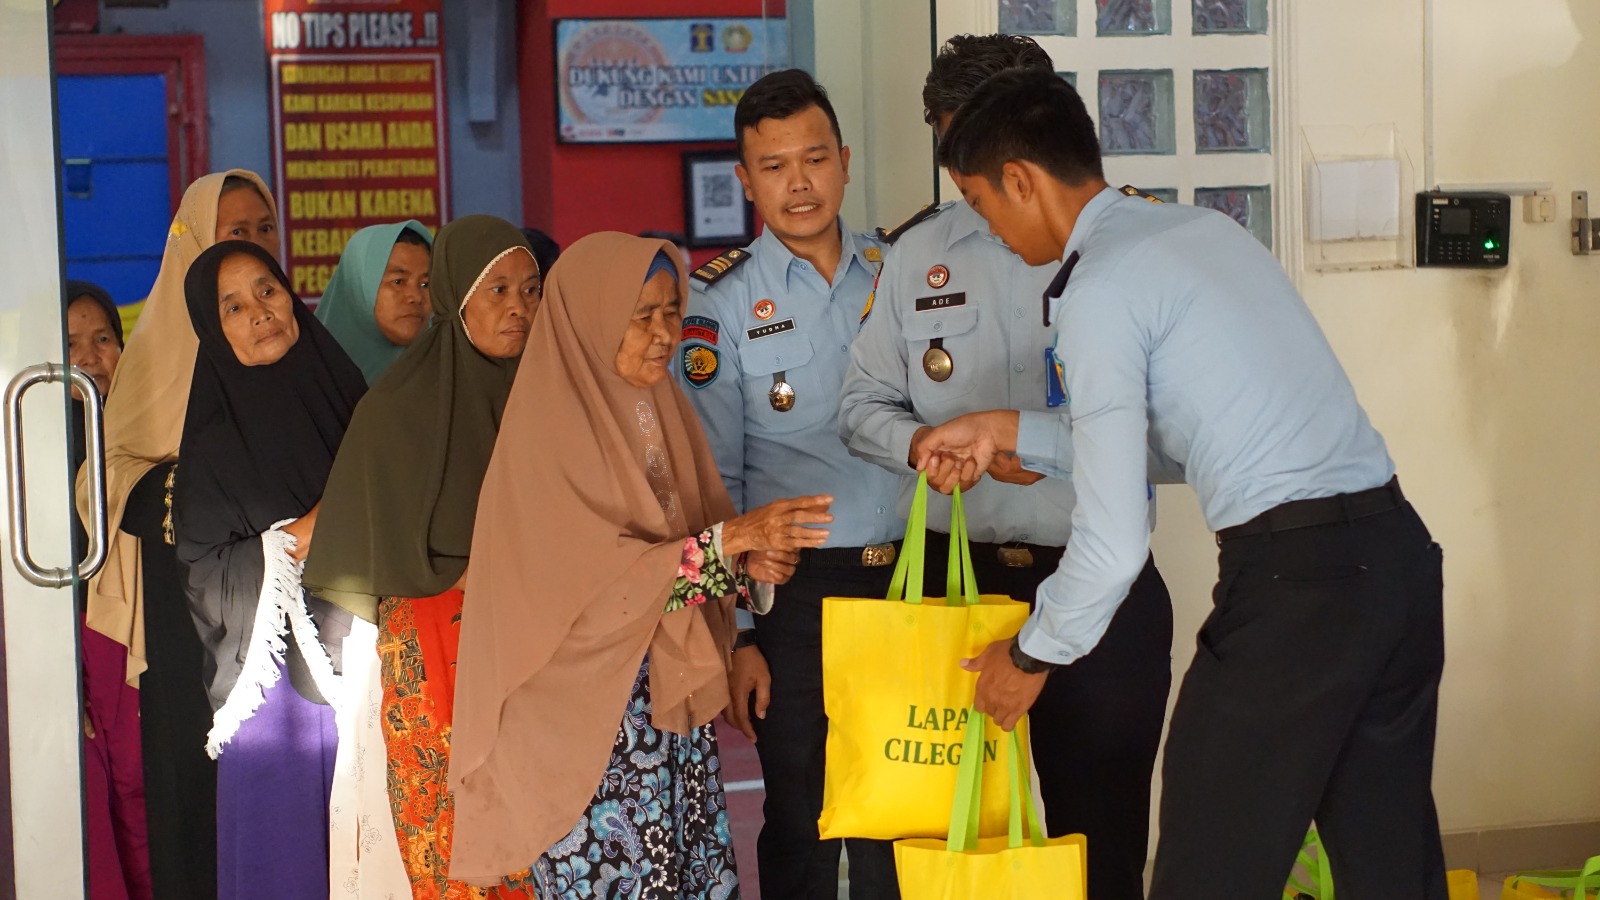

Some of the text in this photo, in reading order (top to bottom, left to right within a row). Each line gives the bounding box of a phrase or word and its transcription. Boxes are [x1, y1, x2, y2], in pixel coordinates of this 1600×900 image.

[271, 12, 300, 49] NO
[302, 12, 346, 48] TIPS
[348, 12, 414, 47] PLEASE
[569, 65, 778, 87] DUKUNG KAMI UNTU
[283, 93, 434, 113] KAMI KARENA KESOPANAN
[617, 88, 697, 109] DENGAN
[285, 121, 435, 150] DAN USAHA ANDA
[286, 158, 437, 179] MENGIKUTI PERATURAN
[289, 188, 437, 220] BUKAN KARENA
[931, 297, 950, 306] ADE
[906, 704, 969, 731] LAPA
[884, 738, 998, 766] CILEGN
